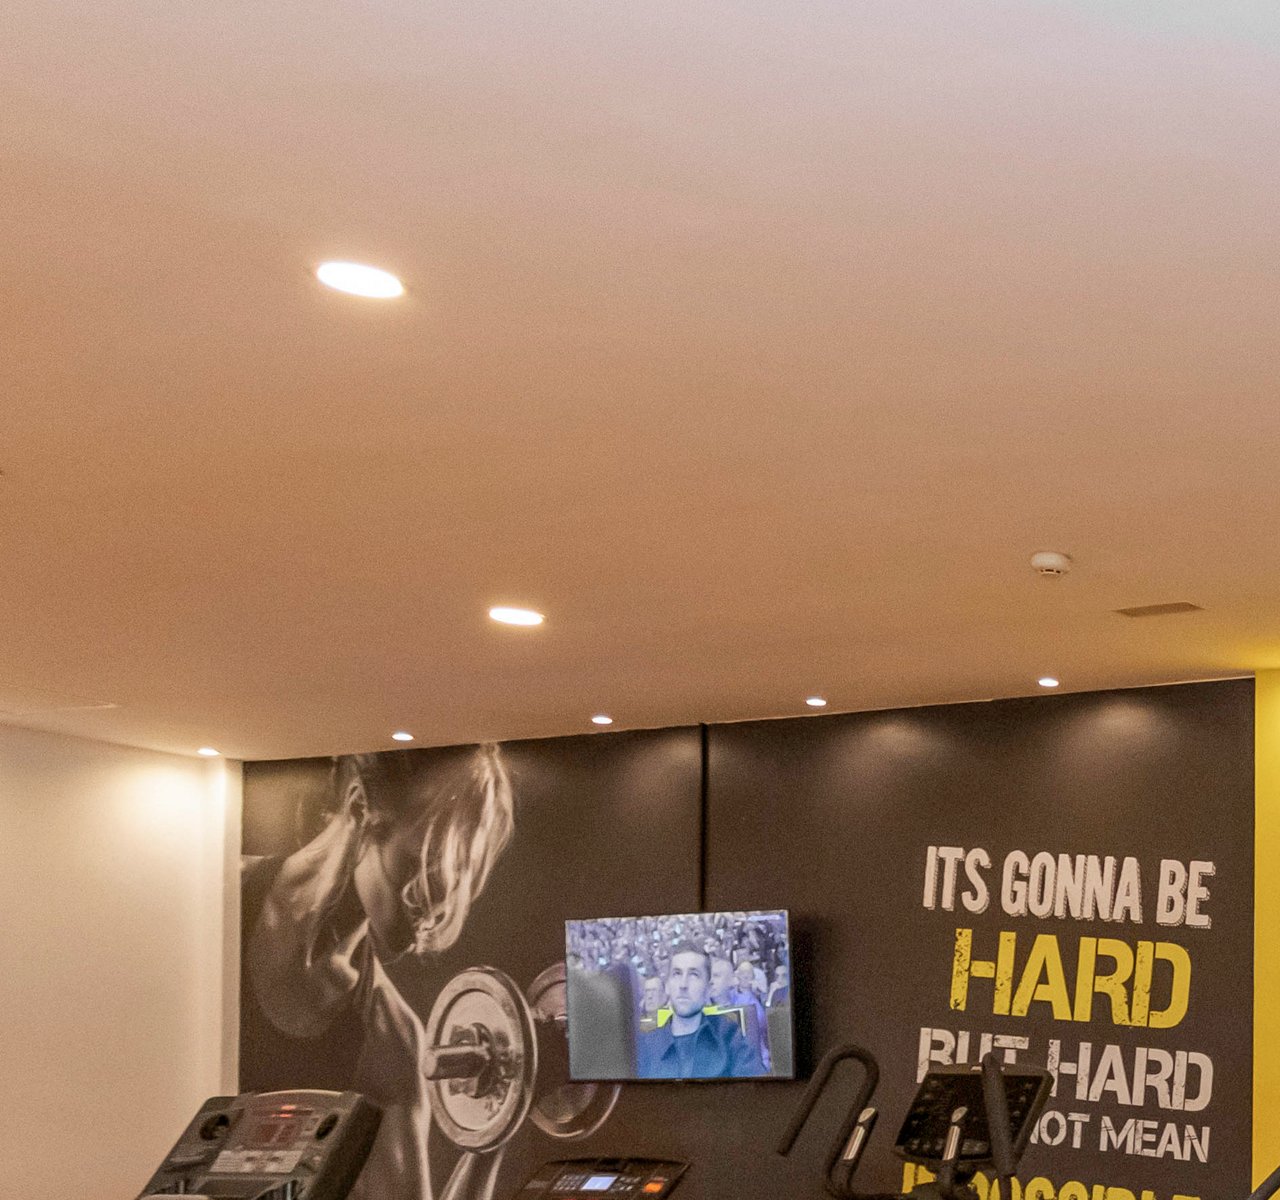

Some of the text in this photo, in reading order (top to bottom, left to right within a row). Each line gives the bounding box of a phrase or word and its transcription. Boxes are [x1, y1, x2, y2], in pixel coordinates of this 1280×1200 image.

[923, 845, 1216, 929] ITS GONNA BE
[950, 928, 1192, 1028] HARD
[1046, 1039, 1214, 1112] HARD
[1031, 1110, 1211, 1163] OT MEAN
